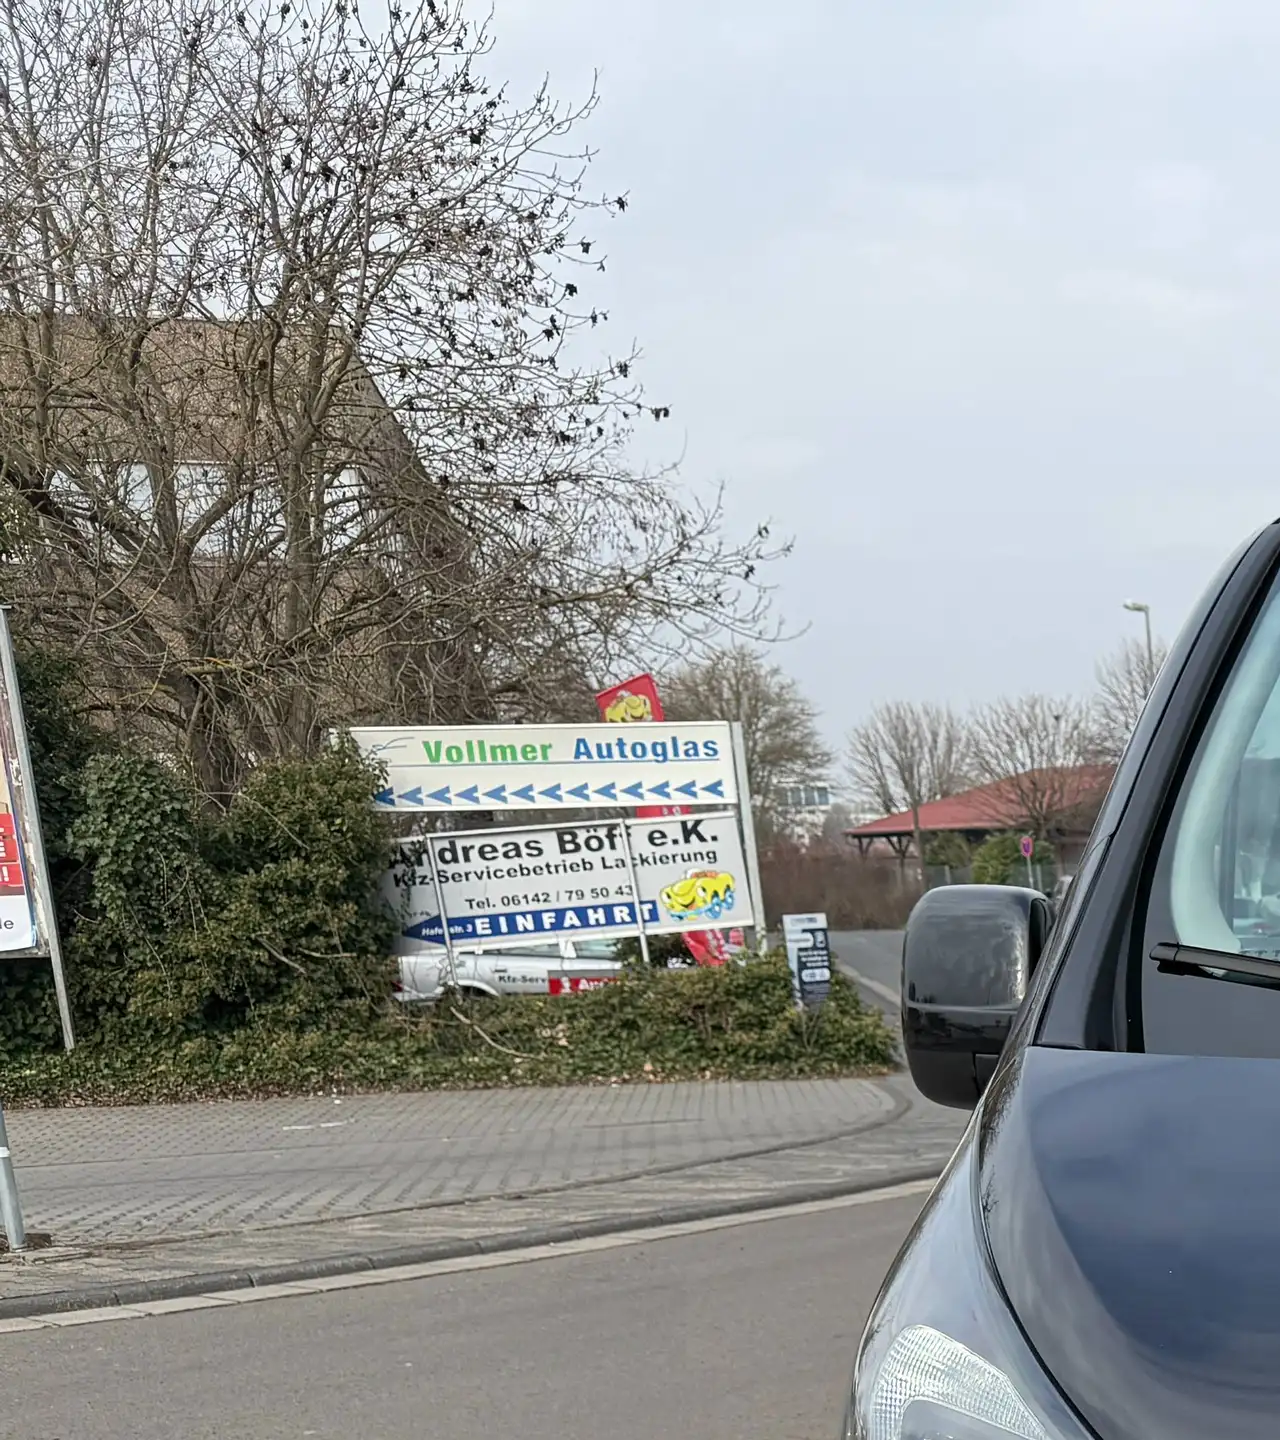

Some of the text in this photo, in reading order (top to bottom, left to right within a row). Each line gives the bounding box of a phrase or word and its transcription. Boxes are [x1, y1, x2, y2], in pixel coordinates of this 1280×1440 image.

[422, 736, 720, 764] Vollmer Autoglas
[648, 820, 718, 847] e.K.
[393, 858, 594, 887] Kfz-Servicebetrieb
[465, 898, 496, 910] Tel.
[501, 892, 551, 907] 06142
[565, 890, 585, 901] 79
[591, 886, 609, 898] 50
[615, 884, 634, 897] 43
[474, 905, 653, 935] EINFAHRT
